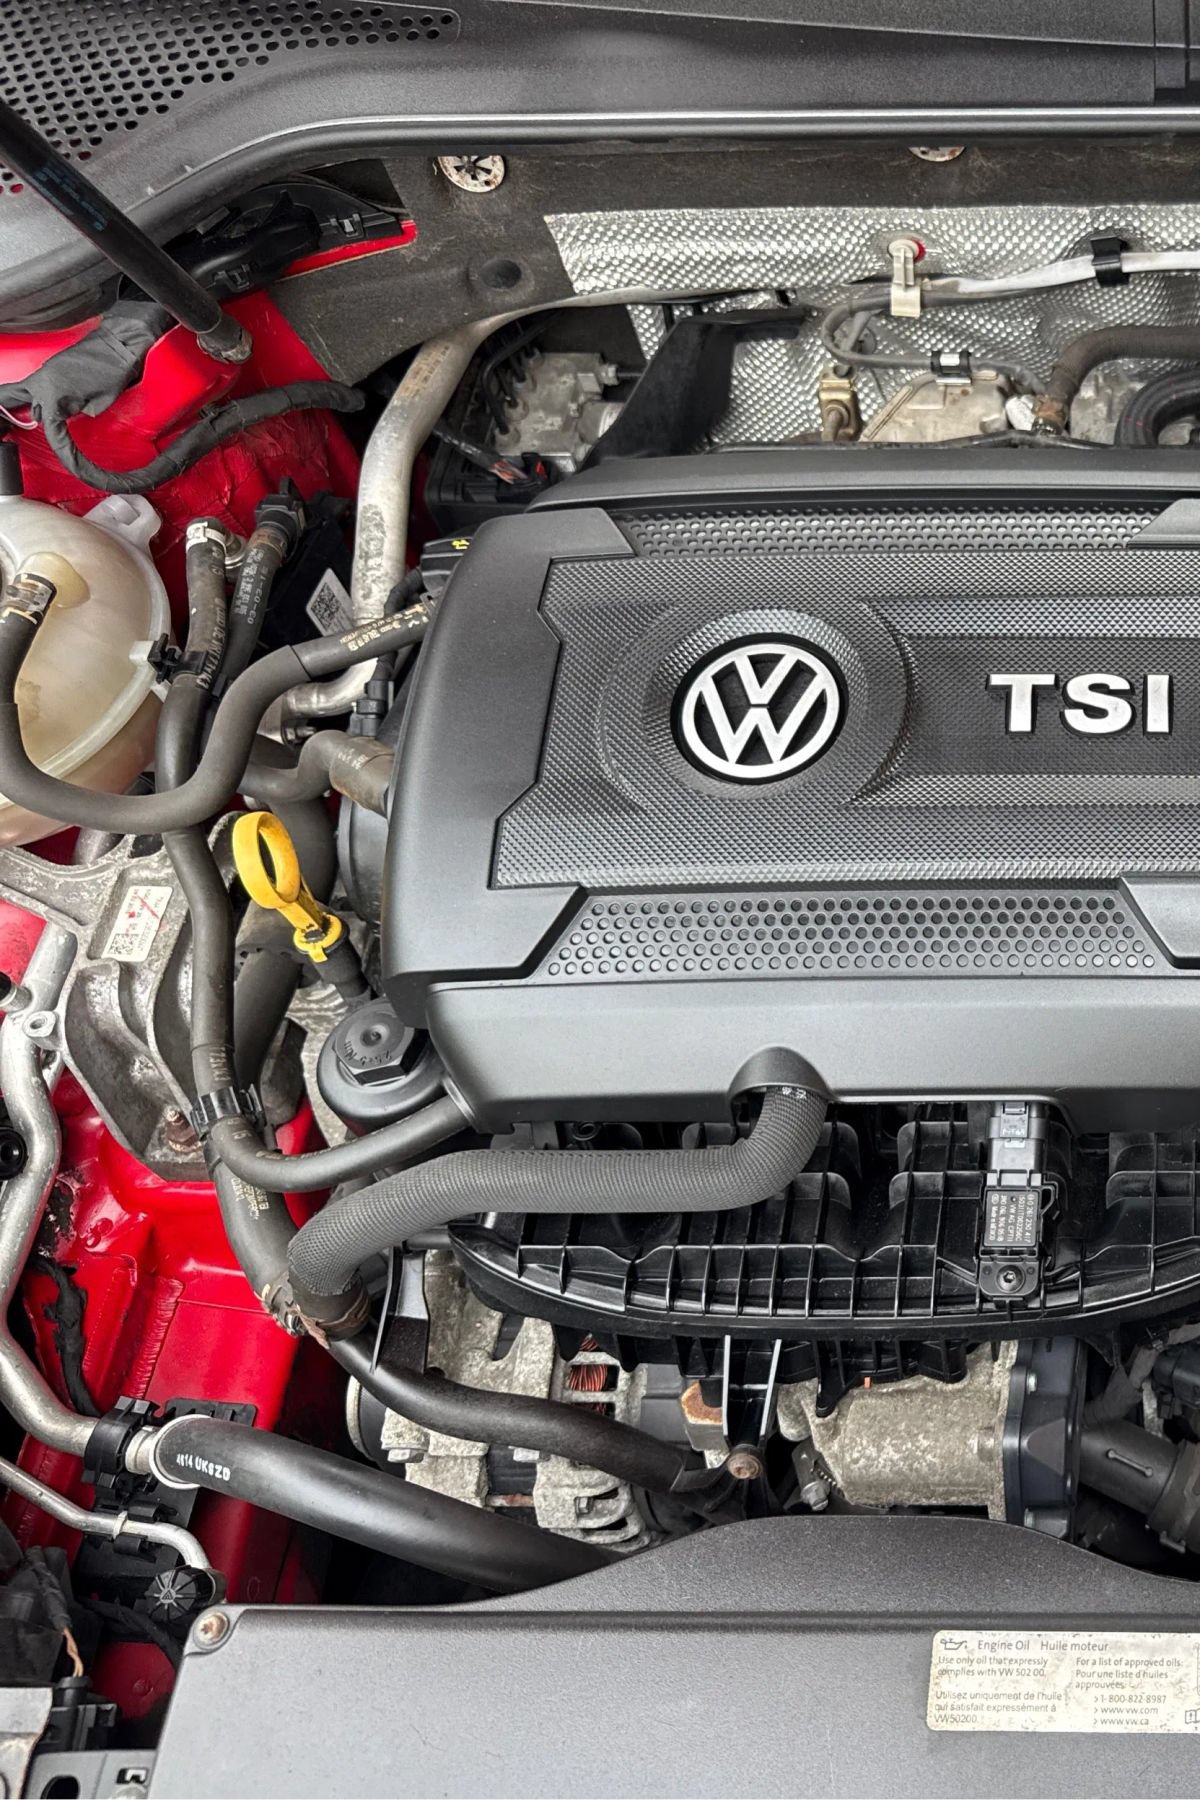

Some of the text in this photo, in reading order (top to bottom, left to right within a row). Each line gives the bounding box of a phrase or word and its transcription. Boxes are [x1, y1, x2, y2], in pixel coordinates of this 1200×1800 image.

[987, 673, 1171, 734] TSI
[682, 643, 840, 778] VW
[978, 1640, 1108, 1651] Engine Oil Huile moteur
[938, 1656, 1048, 1668] Use only oil that expressly
[1076, 1658, 1090, 1667] For
[1099, 1657, 1112, 1667] list
[1112, 1657, 1123, 1667] of
[1124, 1658, 1164, 1669] approved
[938, 1667, 976, 1678] complies
[978, 1668, 996, 1676] with
[998, 1668, 1014, 1676] VW
[1015, 1668, 1031, 1677] 502
[1076, 1670, 1094, 1679] Pour
[1097, 1671, 1113, 1679] une
[1115, 1670, 1133, 1679] liste
[936, 1691, 968, 1701] Utilisez
[970, 1692, 1021, 1703] uniquement
[1023, 1692, 1035, 1701] de
[934, 1704, 948, 1714] qui
[950, 1703, 984, 1713] satisfait
[1100, 1706, 1158, 1714] www.vw.com
[1100, 1718, 1150, 1726] www.vw.ca
